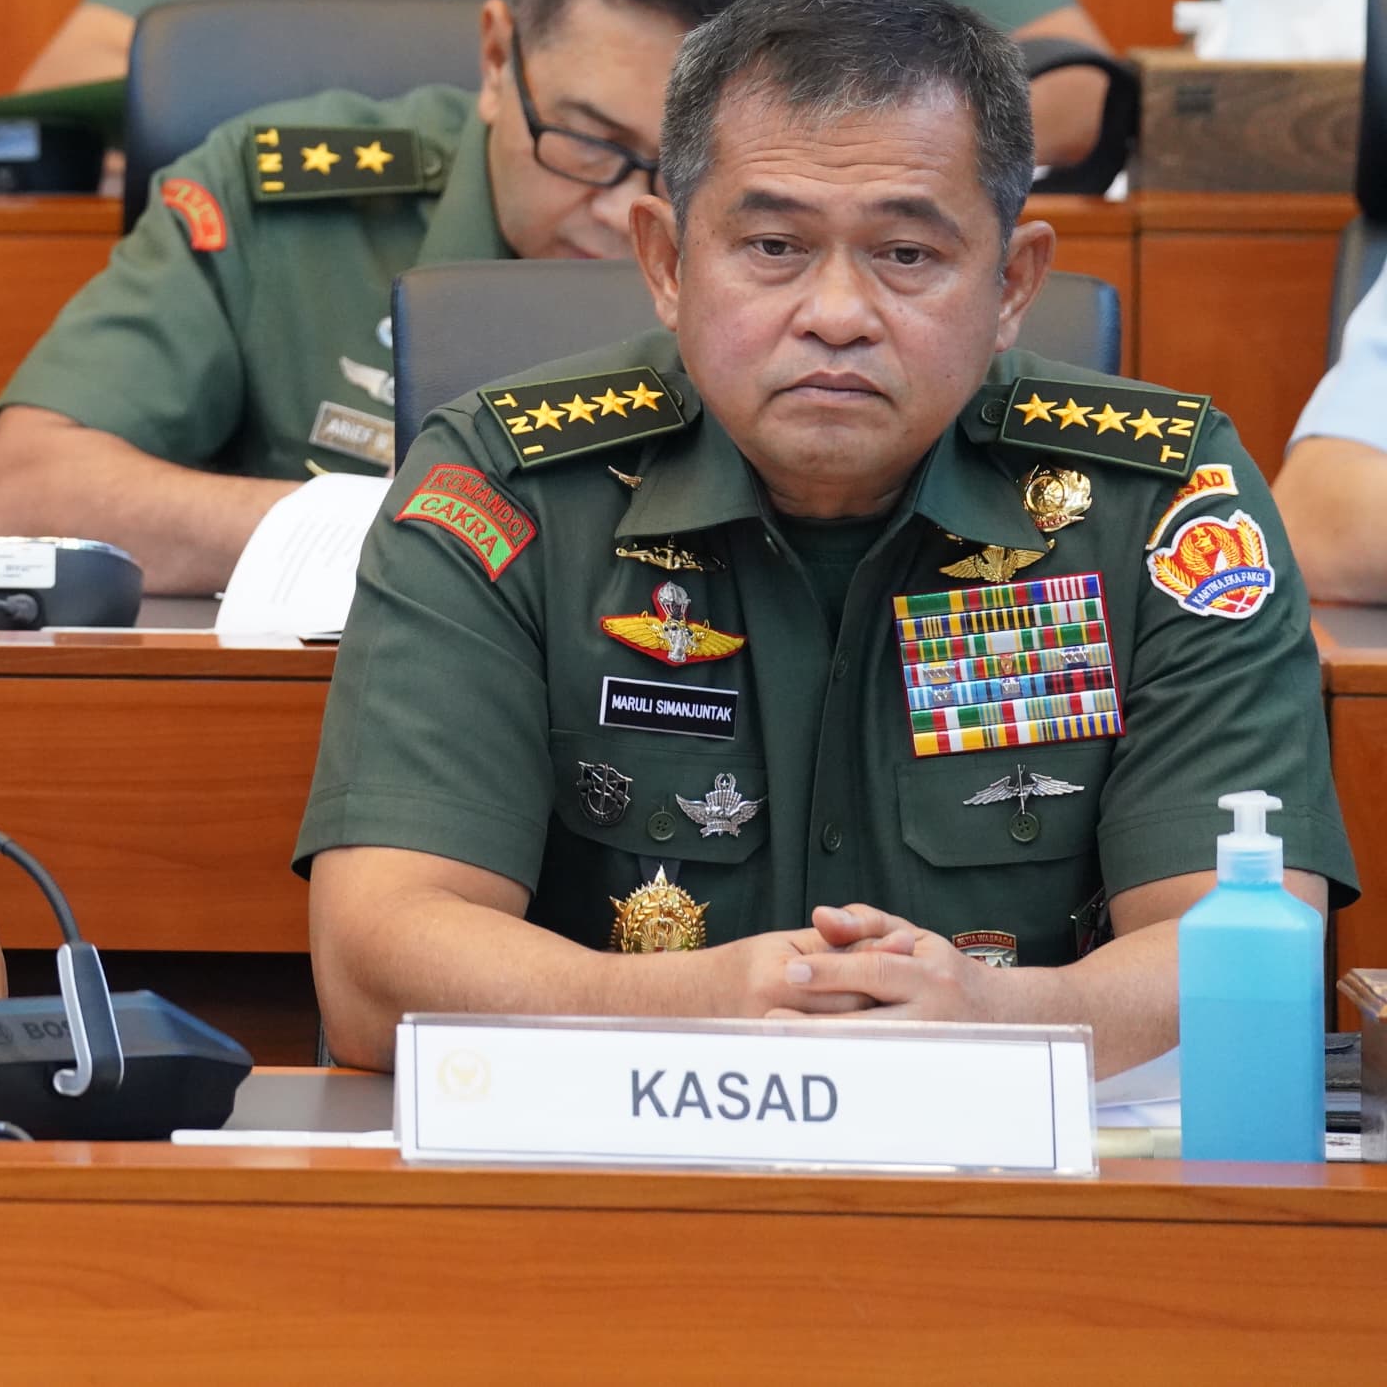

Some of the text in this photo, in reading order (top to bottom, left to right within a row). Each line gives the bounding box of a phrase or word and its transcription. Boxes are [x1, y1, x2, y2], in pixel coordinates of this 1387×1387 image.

[255, 128, 285, 192] TNI
[493, 393, 545, 455] TNI
[1160, 400, 1201, 463] TNI
[420, 497, 499, 557] CAKRA
[430, 471, 524, 536] KOMANDO
[611, 693, 733, 723] MARULI SIMANJUNTAK
[631, 1069, 839, 1122] KASAD
